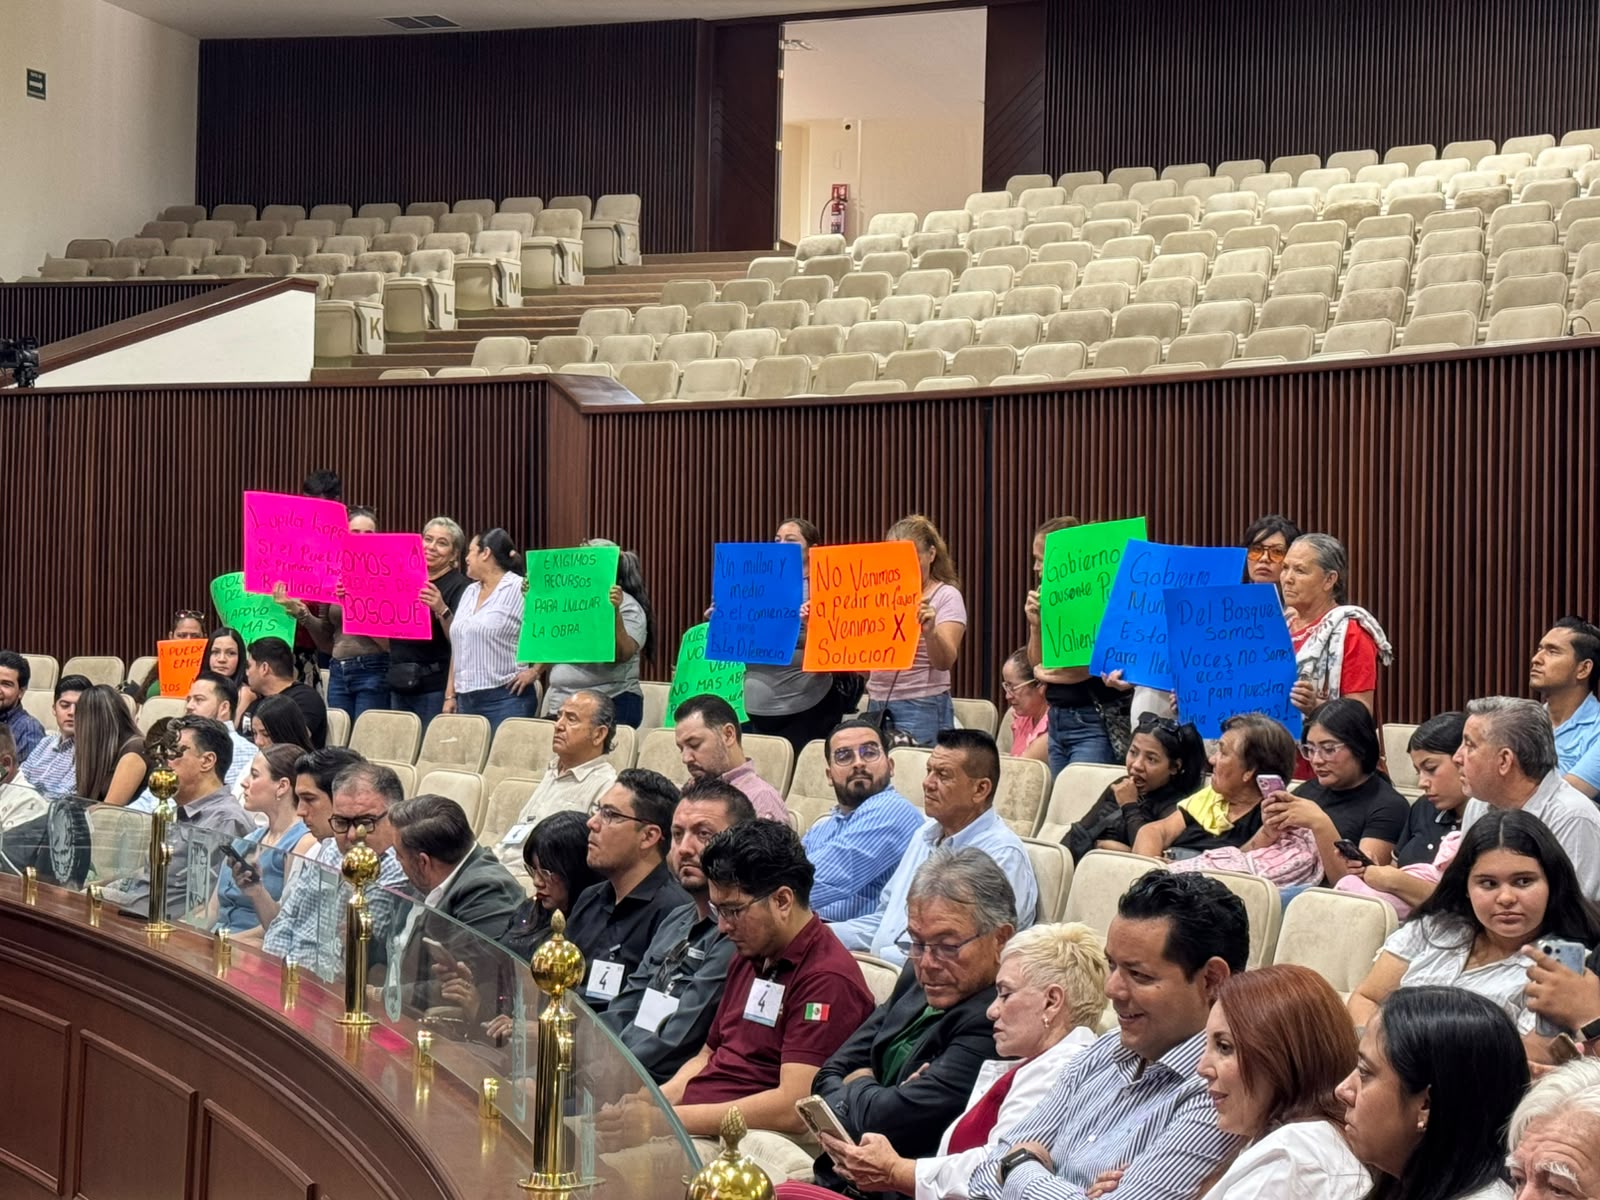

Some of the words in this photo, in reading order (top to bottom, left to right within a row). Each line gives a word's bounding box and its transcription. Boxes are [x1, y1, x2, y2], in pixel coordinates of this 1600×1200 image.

[571, 251, 581, 273] N
[508, 271, 520, 295] M
[370, 316, 382, 341] K
[343, 550, 391, 576] OMOS
[543, 552, 597, 570] EXIGIMOS
[1046, 546, 1121, 583] Gobierno
[1129, 551, 1211, 590] Gobierno
[544, 573, 592, 589] RECURSOS
[849, 558, 902, 593] Venimos
[345, 593, 422, 626] BOSQUE
[534, 597, 558, 614] PARA
[832, 591, 870, 622] pedir
[875, 592, 890, 609] un
[891, 584, 918, 612] favor
[1177, 599, 1213, 627] Del
[241, 618, 278, 634] MAS
[532, 622, 546, 639] LA
[550, 623, 581, 639] OBRA
[828, 615, 886, 642] Venimos
[1046, 615, 1097, 659] Valient
[818, 637, 897, 666] Solucion
[1238, 648, 1258, 668] no
[671, 680, 689, 697] NO
[696, 675, 723, 692] MAS
[1196, 669, 1234, 684] ecos
[1240, 679, 1286, 700] nuestra
[598, 970, 609, 991] 4
[757, 991, 768, 1014] 4
